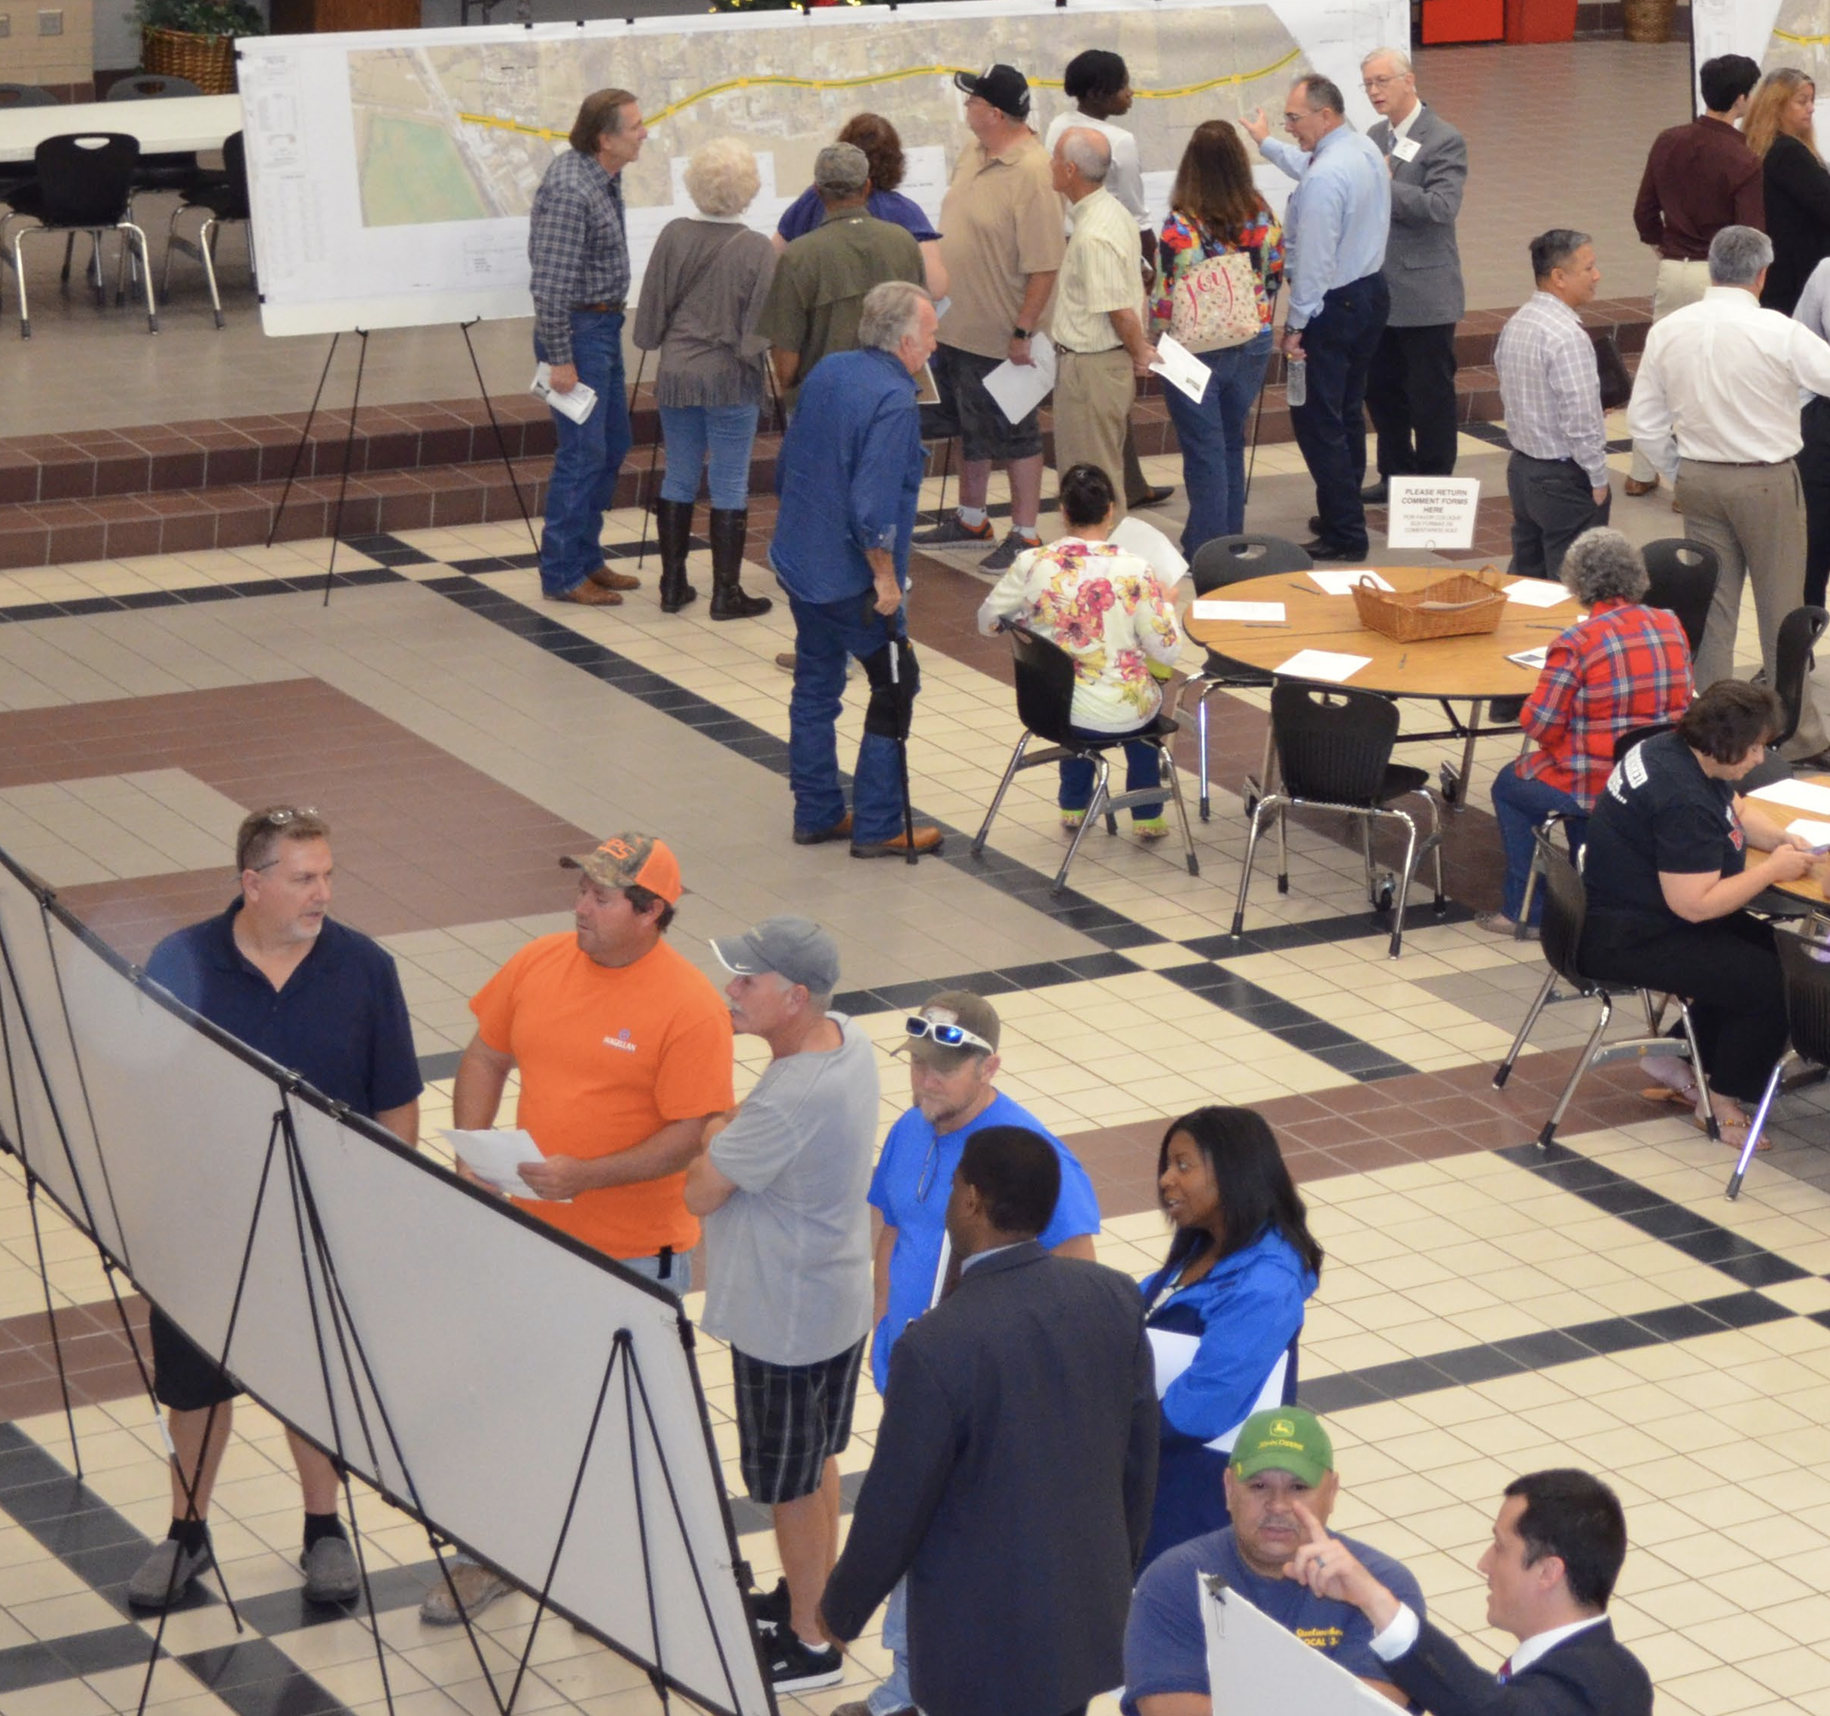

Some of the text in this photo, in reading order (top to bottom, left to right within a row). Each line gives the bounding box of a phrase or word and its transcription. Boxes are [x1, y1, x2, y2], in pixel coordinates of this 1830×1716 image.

[1405, 488, 1434, 496] PLEASE
[1401, 497, 1468, 505] COMMENT FORMS
[1423, 506, 1443, 514] HERE
[1279, 1439, 1305, 1451] DEERE
[1302, 1637, 1327, 1647] OCAL
